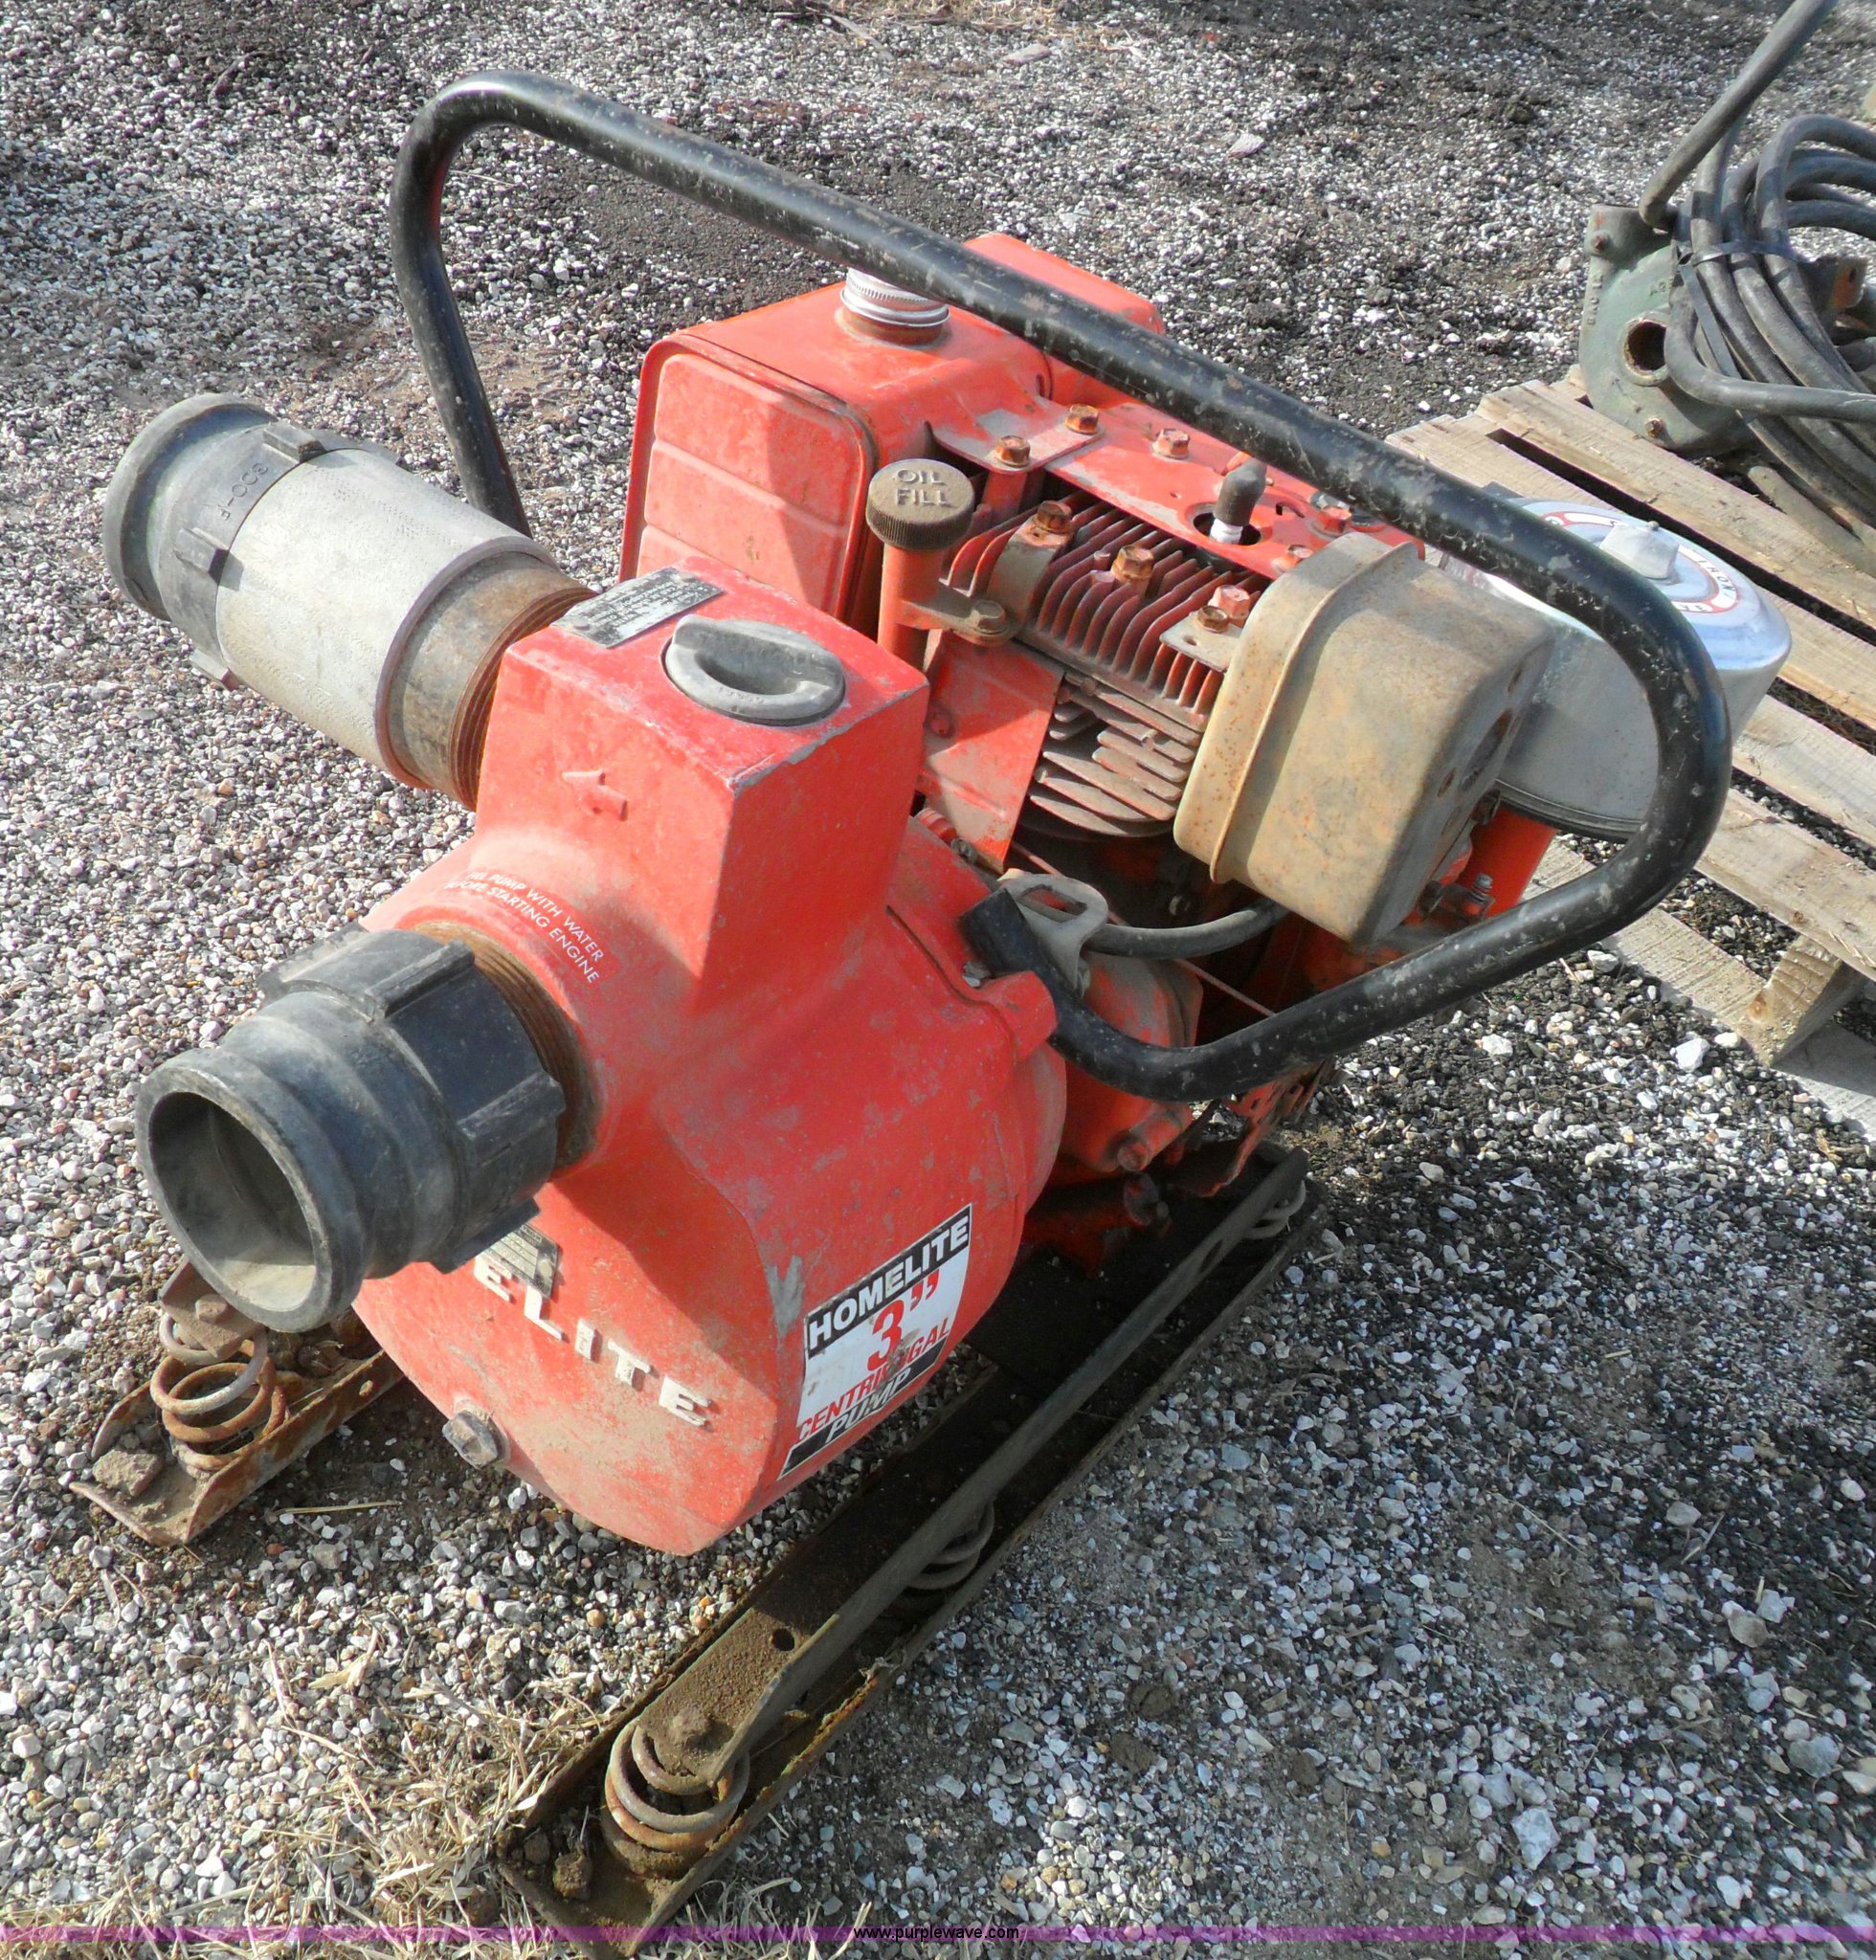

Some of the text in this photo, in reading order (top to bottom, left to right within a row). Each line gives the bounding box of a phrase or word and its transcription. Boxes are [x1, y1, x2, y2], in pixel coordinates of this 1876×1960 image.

[896, 488, 951, 506] FILL
[897, 469, 946, 485] OIL
[486, 887, 550, 928] STARTING
[549, 927, 600, 984] ENGINE
[488, 874, 526, 891] PUMP
[526, 889, 564, 918] WITH
[563, 918, 605, 962] WATER
[808, 1214, 969, 1350] HOMELITE
[798, 1317, 950, 1440] CENTRIGAL
[825, 1367, 912, 1443] PUMP
